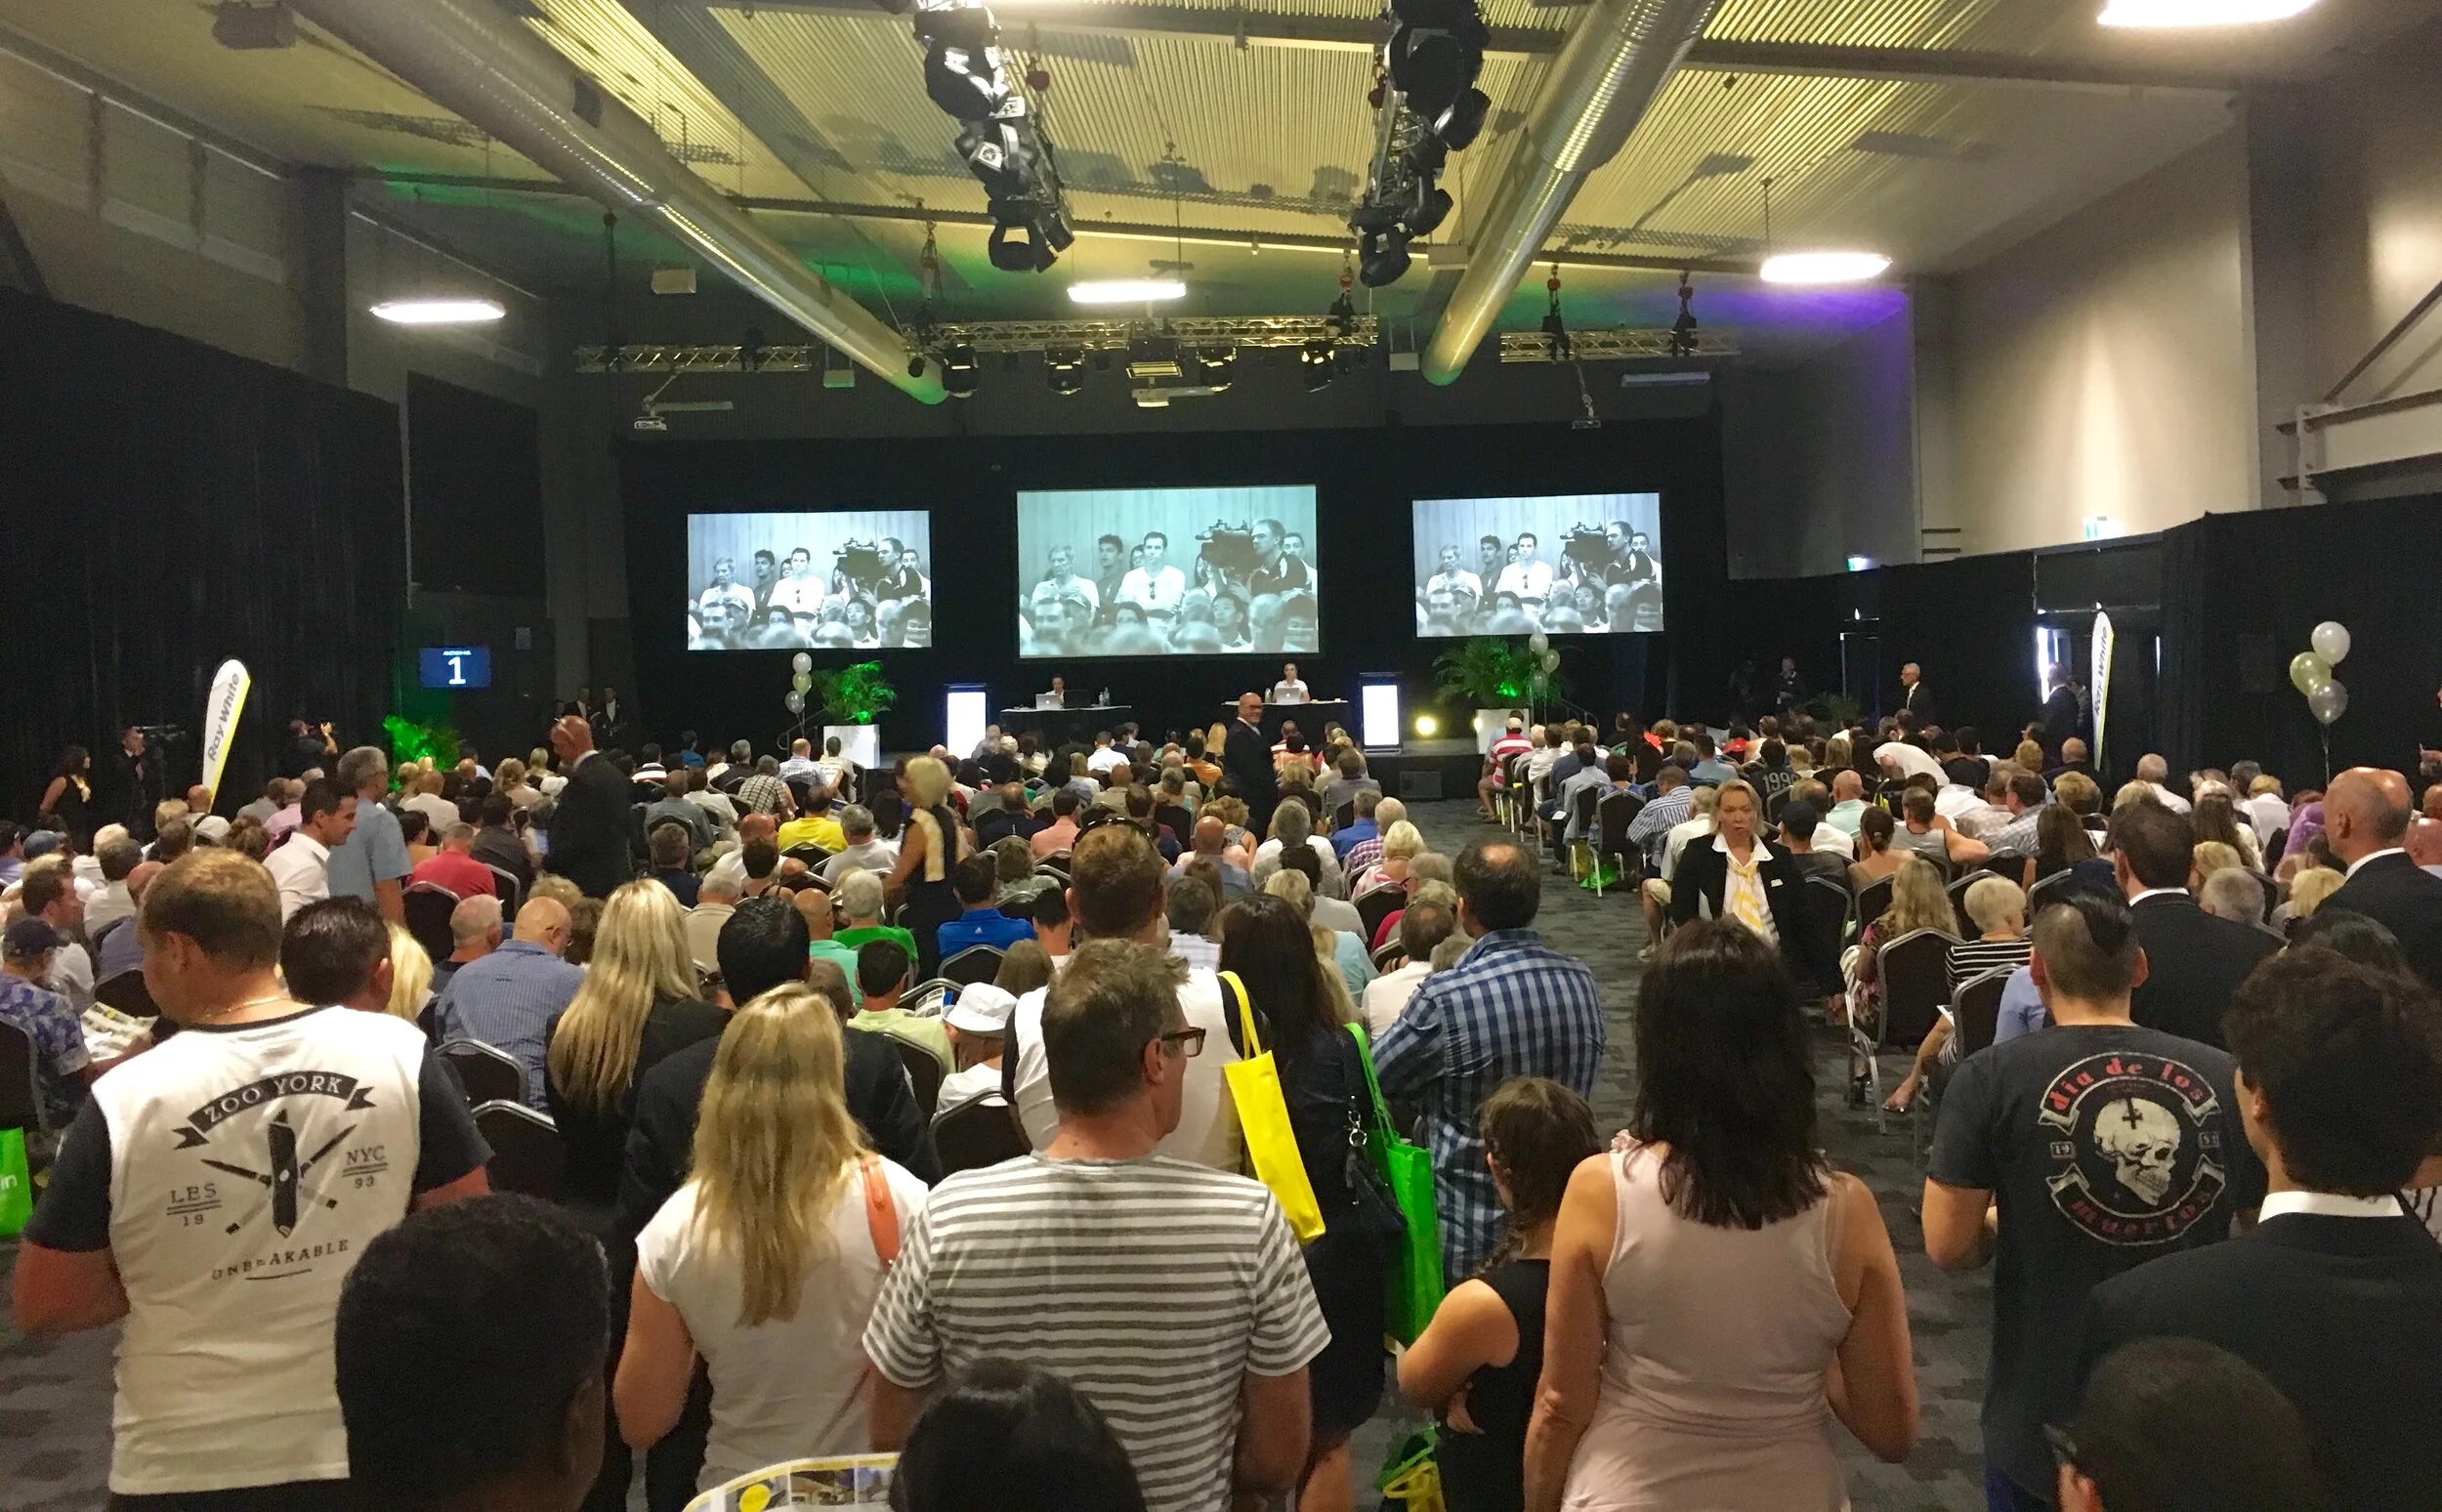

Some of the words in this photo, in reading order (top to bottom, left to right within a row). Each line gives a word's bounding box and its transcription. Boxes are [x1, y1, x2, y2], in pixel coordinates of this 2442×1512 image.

[448, 656, 466, 685] 1
[207, 725, 224, 762] Ray
[219, 673, 239, 723] White
[2105, 1057, 2143, 1075] de
[204, 1087, 261, 1123] ZOO
[274, 1075, 343, 1095] YORK
[346, 1145, 386, 1165] NYC
